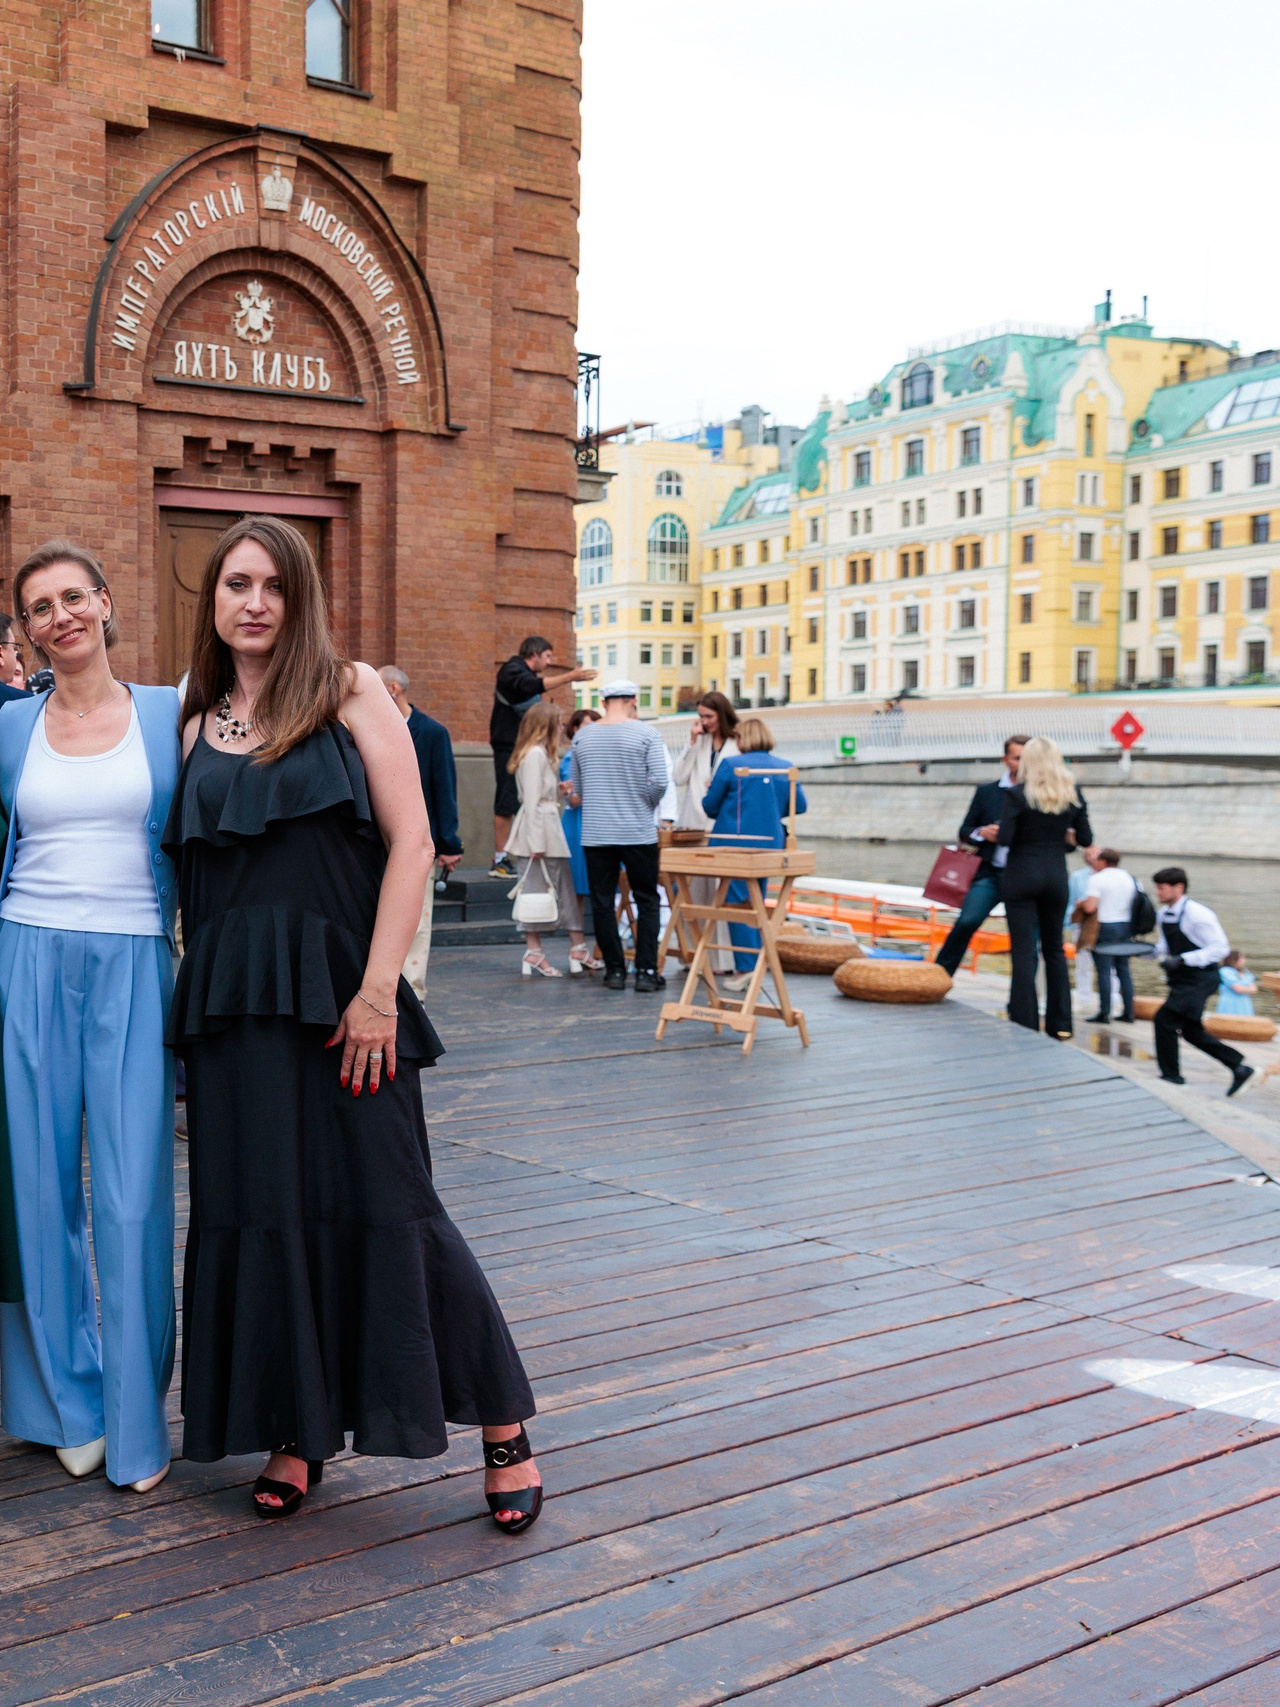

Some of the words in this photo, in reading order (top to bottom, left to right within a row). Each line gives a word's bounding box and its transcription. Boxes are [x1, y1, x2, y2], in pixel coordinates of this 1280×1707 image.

[298, 197, 396, 303] МОСКОВСКІЙ
[380, 302, 422, 386] РЕЧНОЙ
[174, 340, 238, 381] ЯХТЪ
[252, 349, 332, 392] КЛУБЪ
